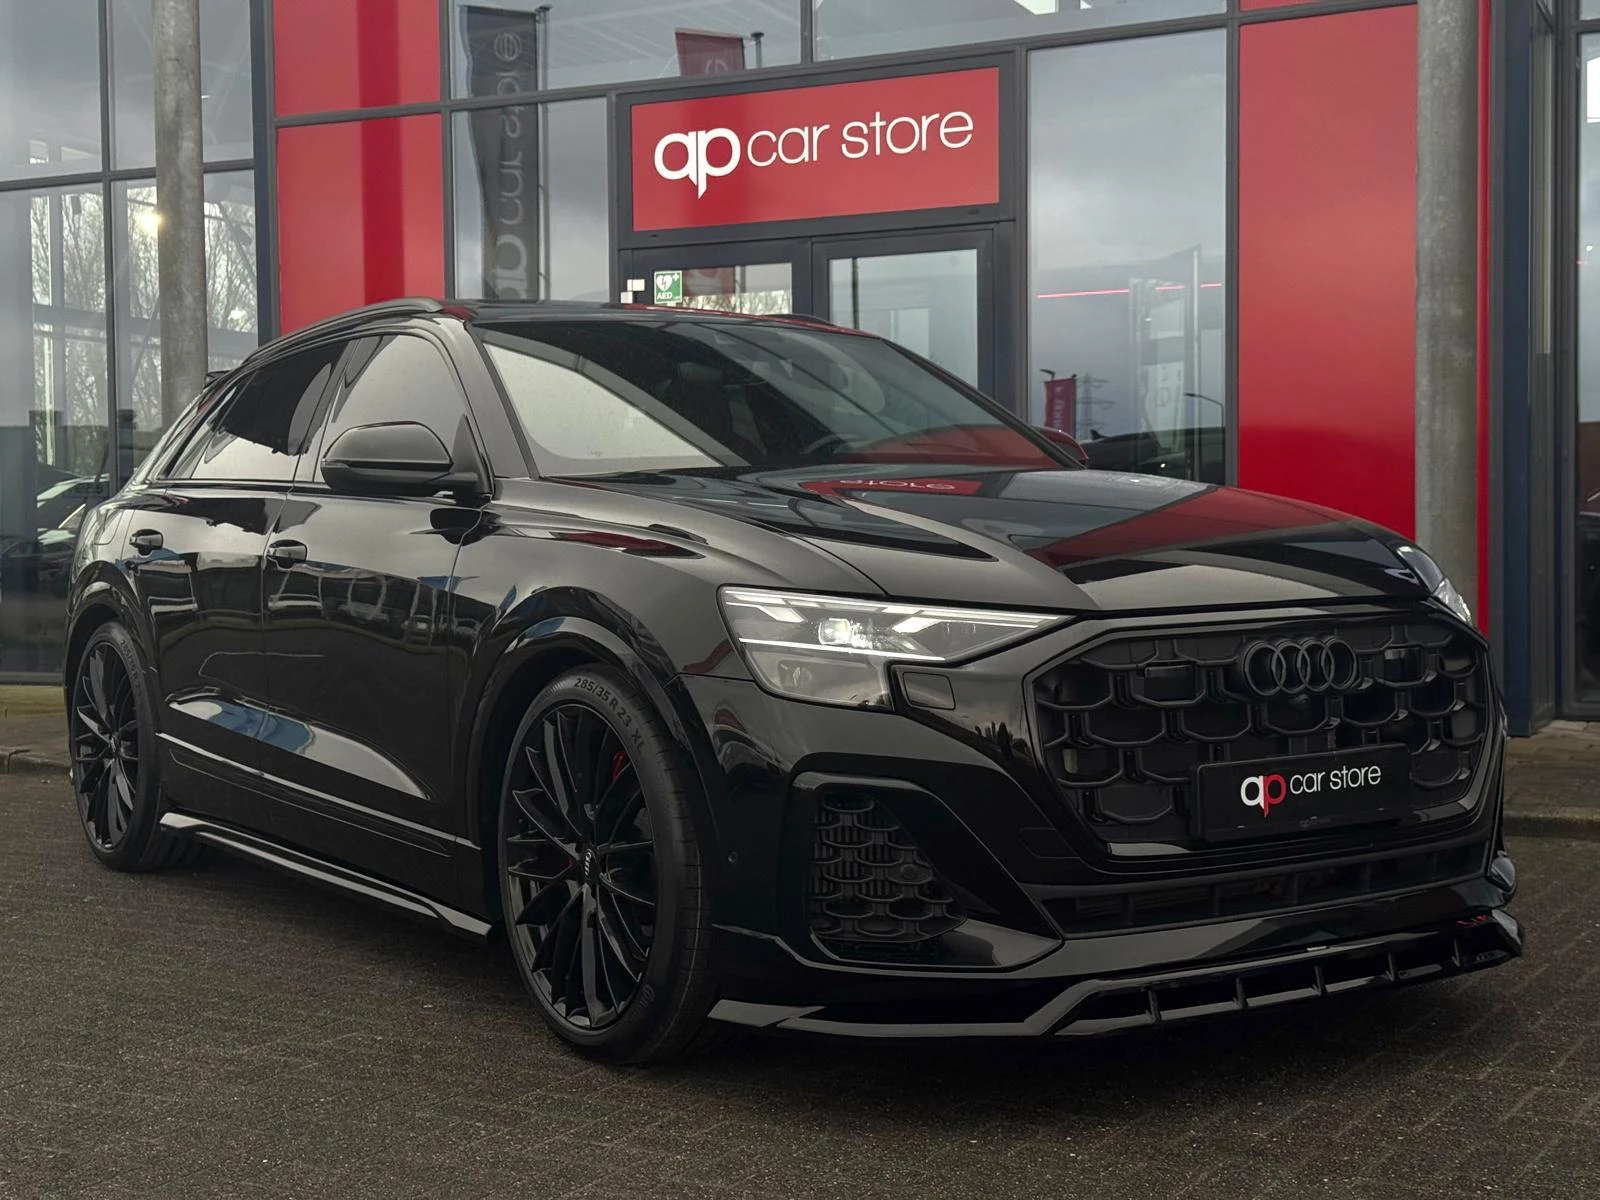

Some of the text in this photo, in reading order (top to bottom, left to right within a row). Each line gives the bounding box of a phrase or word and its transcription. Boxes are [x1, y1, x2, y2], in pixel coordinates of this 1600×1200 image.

[654, 111, 974, 200] ap car store
[656, 291, 673, 300] AED
[574, 677, 611, 702] 285/35
[609, 697, 618, 711] R
[616, 706, 632, 728] 23
[1240, 765, 1382, 818] ap car store
